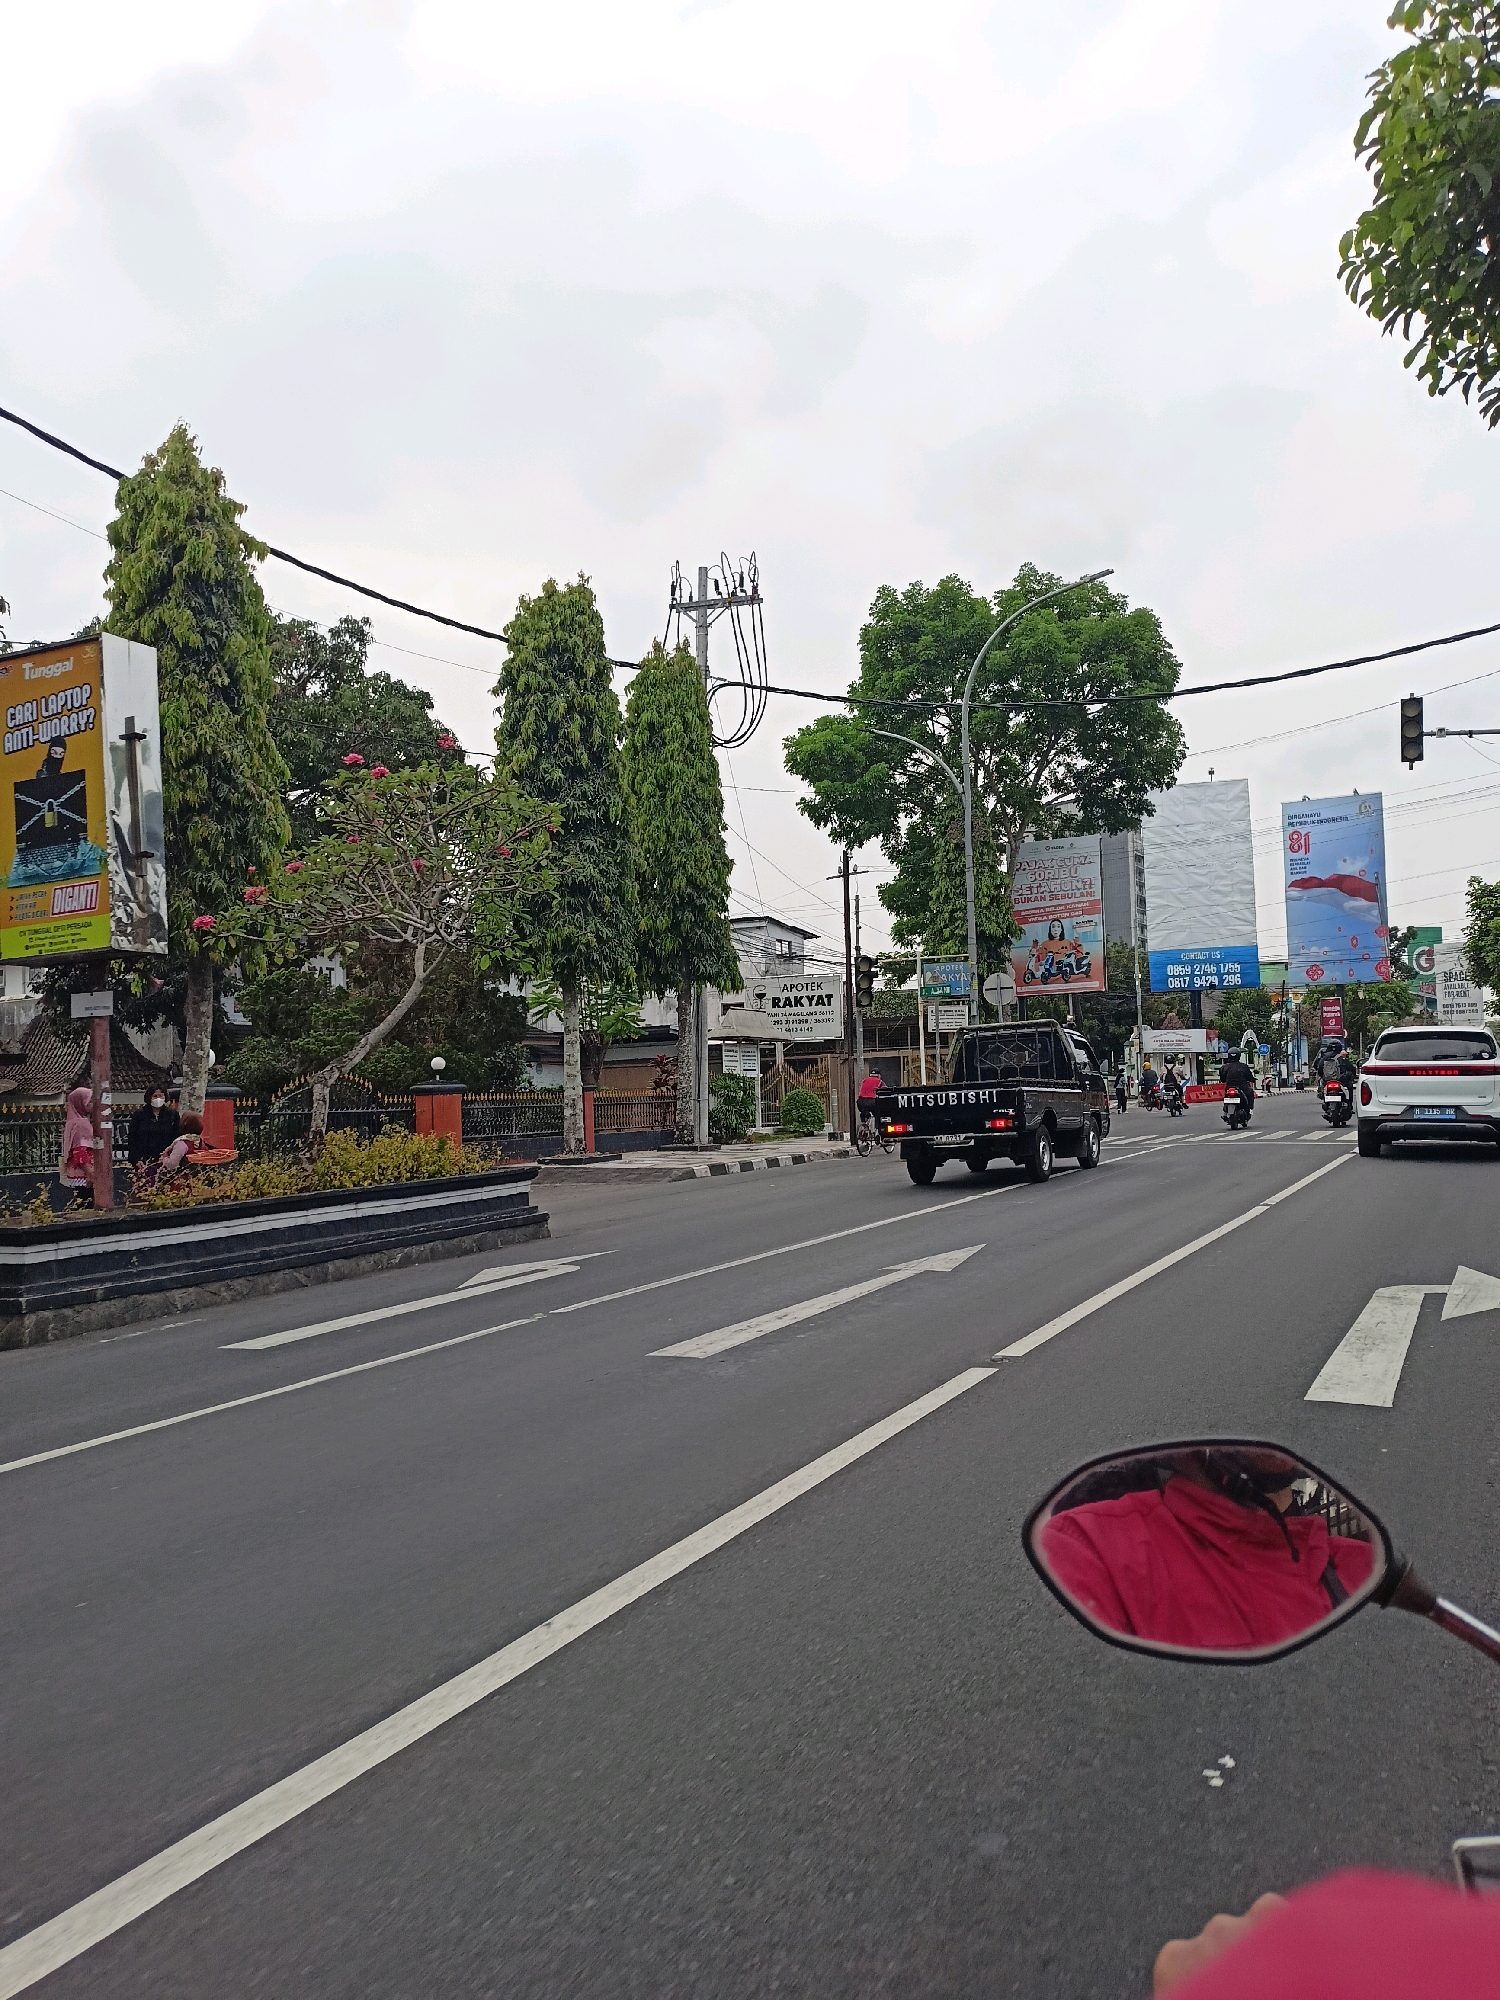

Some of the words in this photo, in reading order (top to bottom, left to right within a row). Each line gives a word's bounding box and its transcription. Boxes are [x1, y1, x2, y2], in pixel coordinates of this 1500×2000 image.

[22, 657, 74, 680] Tunggal
[6, 699, 38, 729] CARI
[40, 683, 92, 718] LAPTOP
[4, 707, 96, 755] ANTI-WORRY?
[1287, 811, 1321, 821] DIRGAHAYU
[1289, 830, 1311, 855] 81
[1015, 859, 1054, 872] PAJAK
[1057, 855, 1092, 867] CUMA
[1027, 866, 1080, 882] 60RIBU
[1013, 877, 1095, 896] SETAHUN?!
[53, 883, 98, 914] DIGANTI
[1014, 895, 1046, 904] BUKAN
[1049, 890, 1096, 901] SEBULAN!
[1181, 952, 1210, 960] CONTACT
[936, 964, 964, 972] APOTEK
[1167, 964, 1191, 976] 0859
[1193, 963, 1217, 975] 2746
[781, 982, 824, 992] APOTEK
[1167, 977, 1189, 988] 0817
[1193, 975, 1219, 988] 9429
[1222, 974, 1241, 986] 296
[771, 993, 834, 1009] RAKYAT
[898, 1089, 998, 1109] MITSUBISHI
